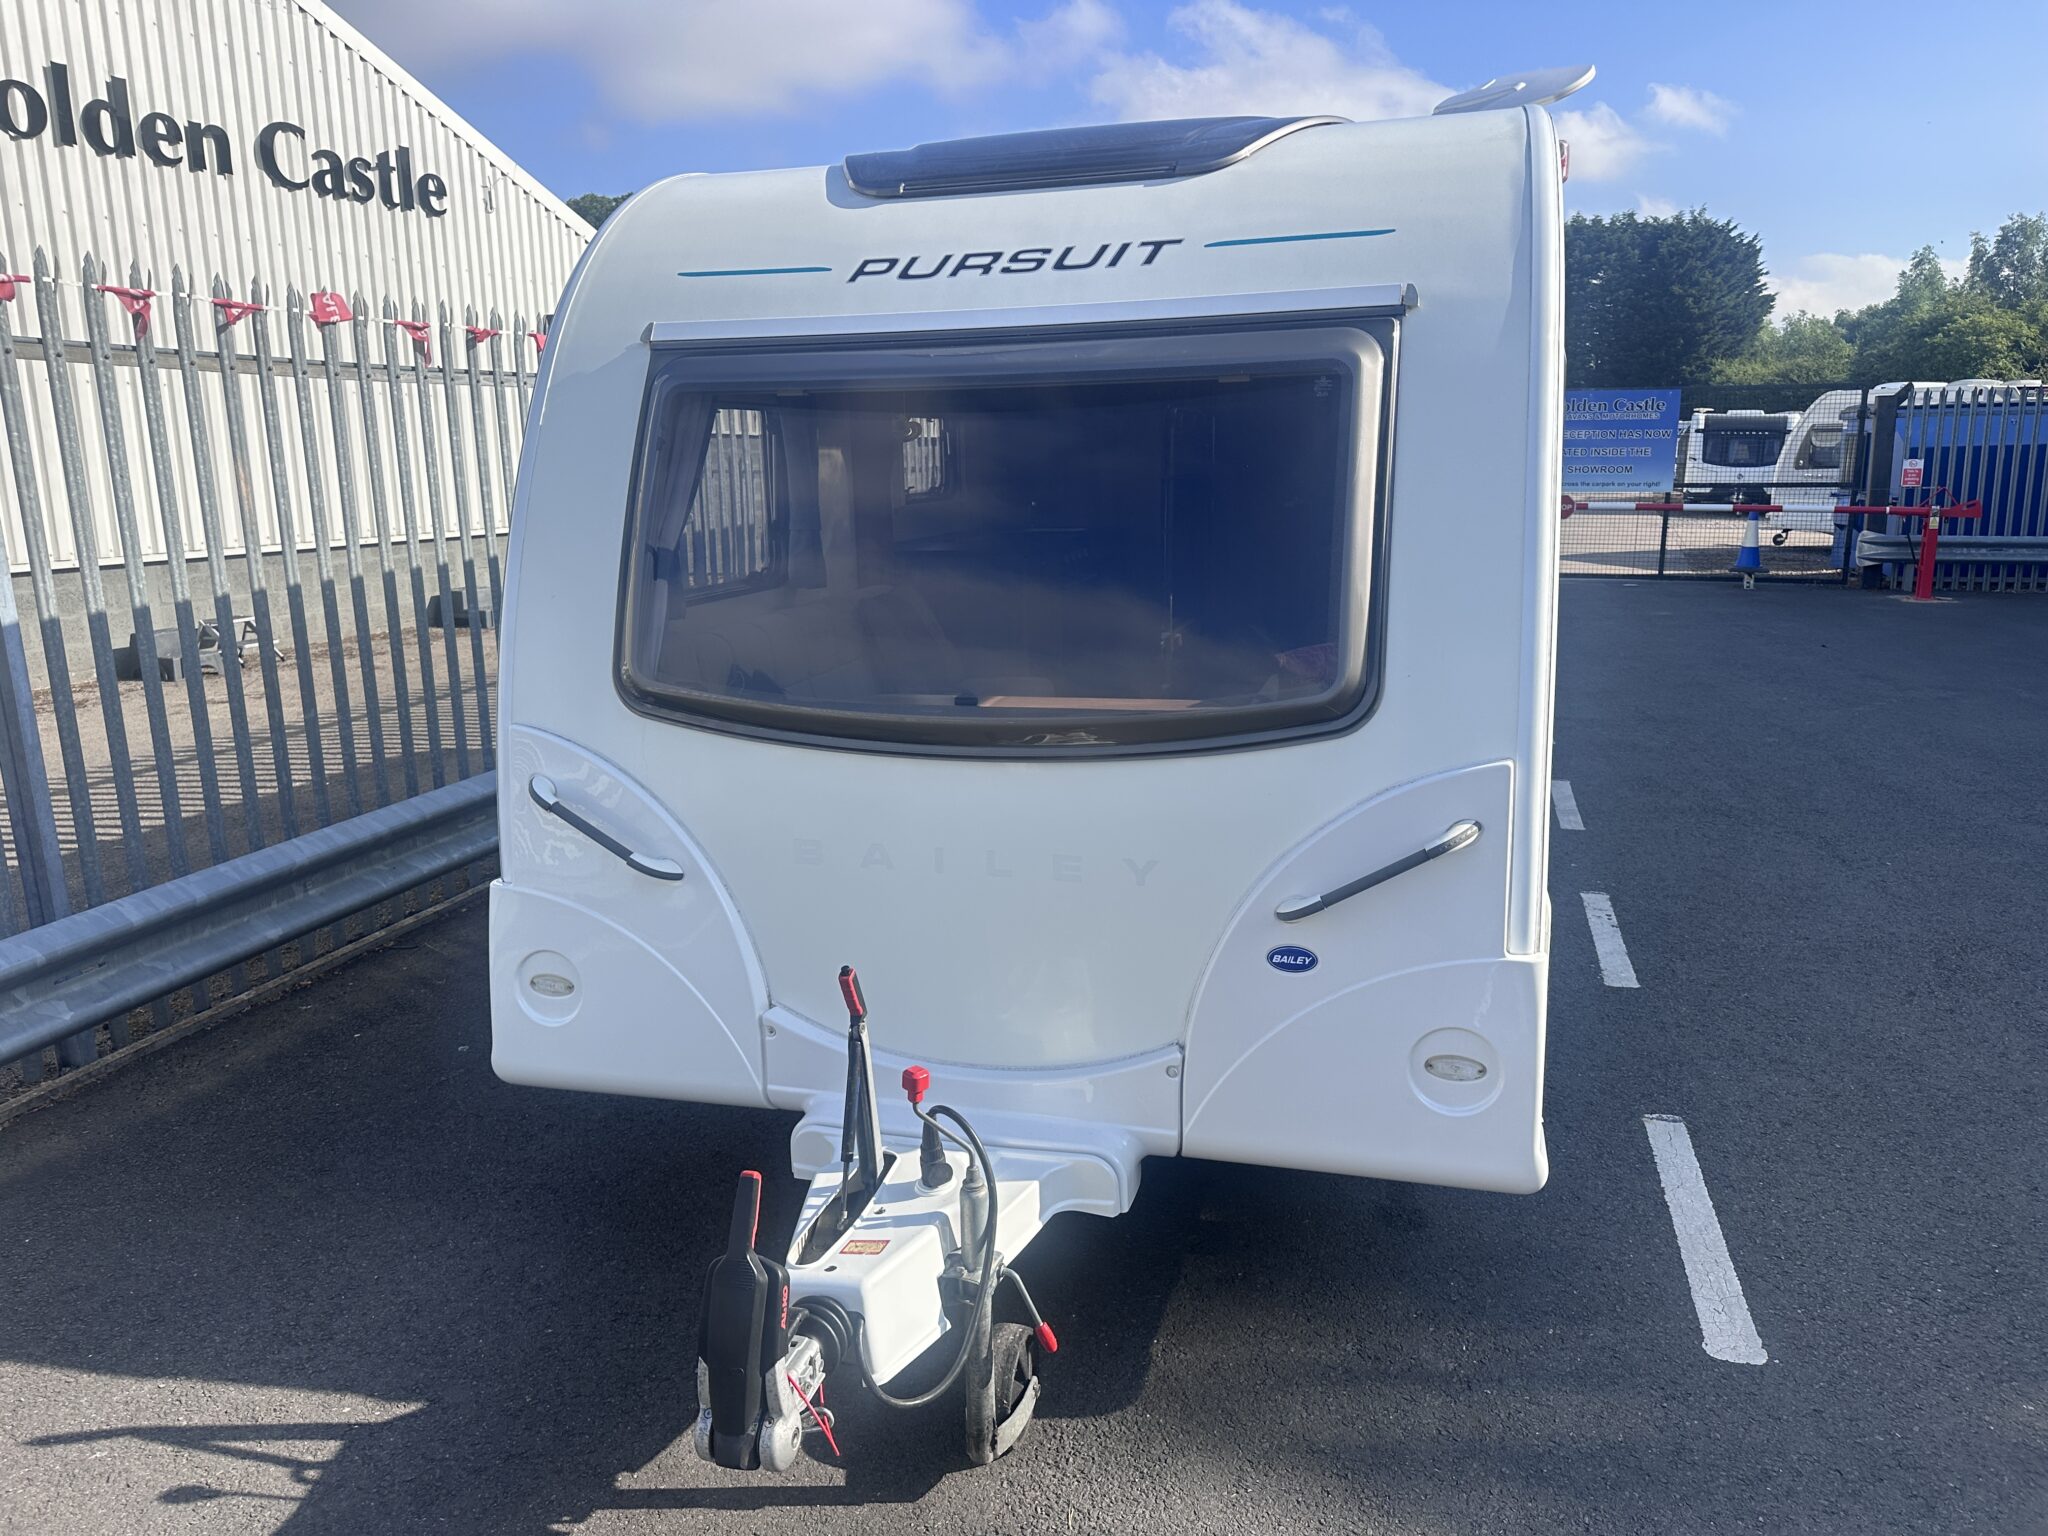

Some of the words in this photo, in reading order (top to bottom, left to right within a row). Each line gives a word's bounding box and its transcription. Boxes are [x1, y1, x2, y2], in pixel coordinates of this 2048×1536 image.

[258, 122, 447, 216] Castle
[847, 238, 1185, 283] PURSUIT
[1613, 397, 1666, 412] Castle
[1619, 430, 1641, 439] HAS
[1645, 429, 1672, 439] NOW
[1591, 448, 1625, 456] INSIDE
[1629, 448, 1651, 456] THE
[1567, 465, 1633, 474] SHOWROOM
[793, 837, 1160, 887] BAILEY
[1272, 955, 1312, 965] BAILEY
